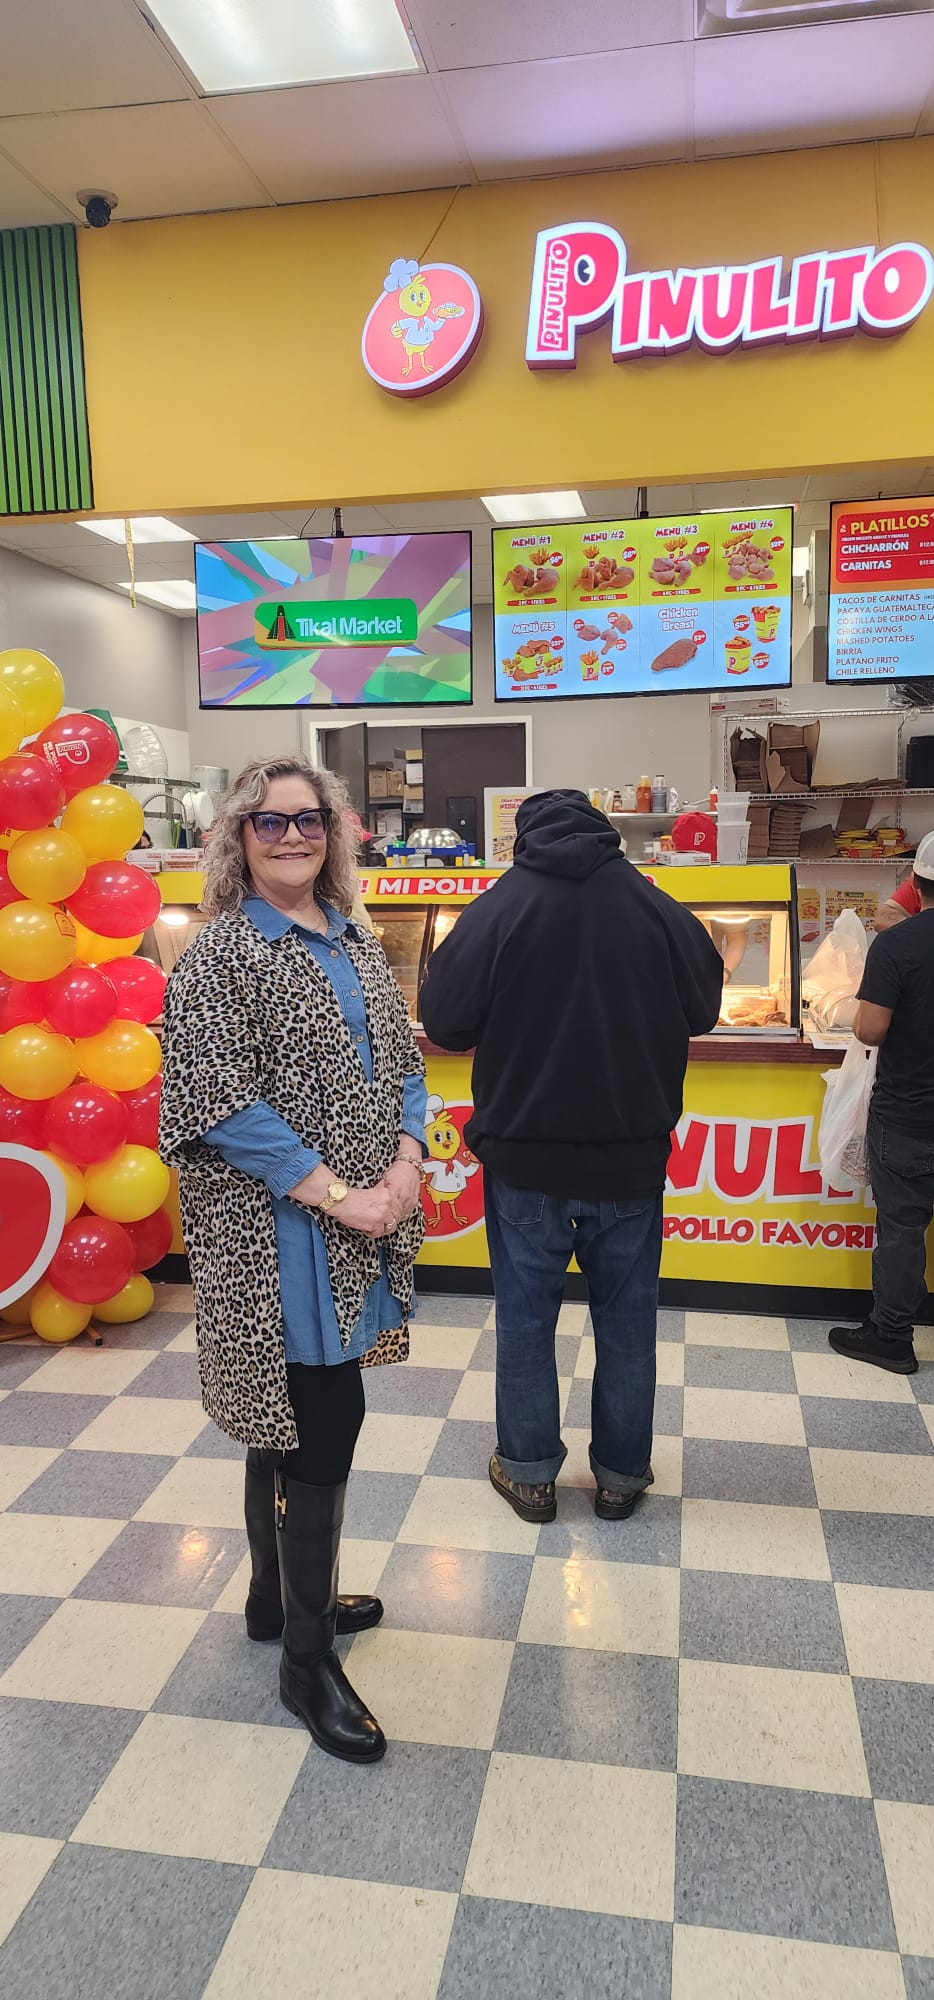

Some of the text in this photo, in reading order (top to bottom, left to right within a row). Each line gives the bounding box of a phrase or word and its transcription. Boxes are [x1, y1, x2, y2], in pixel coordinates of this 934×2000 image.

[526, 221, 934, 360] PINULITO
[540, 239, 571, 349] PINULITO
[684, 525, 698, 534] #3
[760, 520, 774, 529] #4
[850, 514, 929, 535] PLATILLOS
[539, 535, 551, 544] #1
[611, 531, 624, 540] #2
[841, 539, 909, 554] CHICHARRÓN
[841, 560, 891, 571] CARNITAS
[837, 597, 865, 605] TACOS
[879, 594, 920, 603] CARNITAS
[658, 608, 698, 620] Chicken
[837, 607, 871, 615] PACAYA
[837, 617, 875, 625] COSTILLA
[890, 614, 917, 622] CERDO
[295, 616, 402, 636] Tikal Market
[541, 622, 555, 632] #5
[662, 620, 694, 631] Breast
[837, 625, 903, 635] CHICKEN WINGS
[837, 635, 915, 645] MASHED POTATOES
[836, 648, 862, 656] BIRRIA
[836, 656, 899, 666] PLATANO FRITO
[836, 666, 895, 676] CHILE RELLENO
[379, 879, 410, 894] MI
[663, 1216, 877, 1249] POLLO FAVORI
